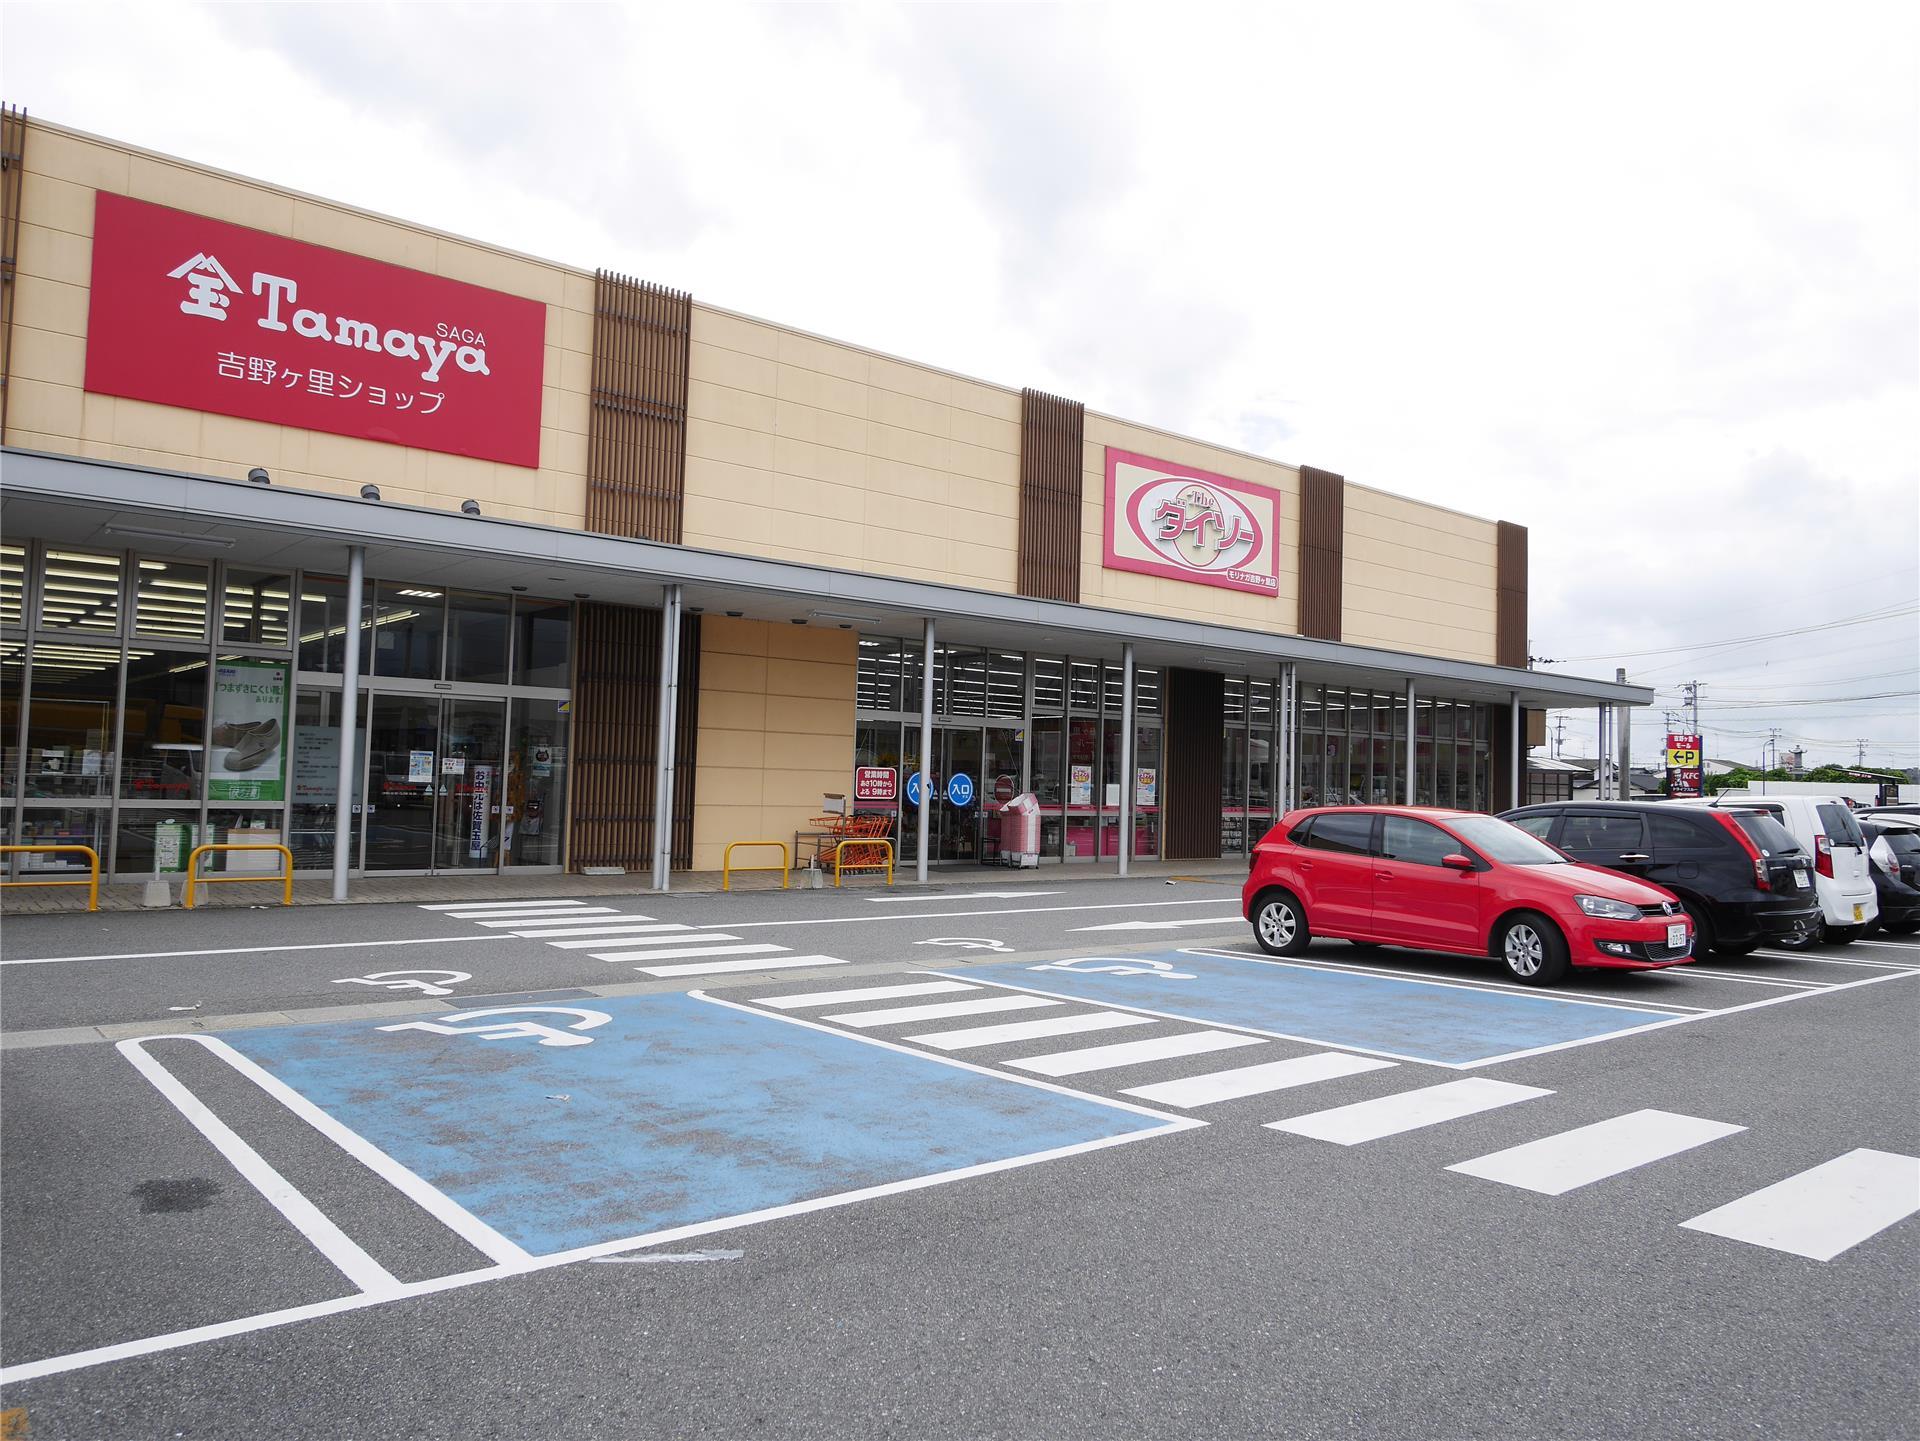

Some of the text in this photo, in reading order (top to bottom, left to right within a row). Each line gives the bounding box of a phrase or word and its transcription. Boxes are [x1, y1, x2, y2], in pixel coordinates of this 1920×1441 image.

[251, 270, 491, 383] Tamaya
[435, 321, 487, 348] SAGA
[1192, 490, 1215, 507] The
[1154, 498, 1255, 552] ダイソー
[1686, 751, 1694, 763] P
[951, 783, 971, 796] 入口
